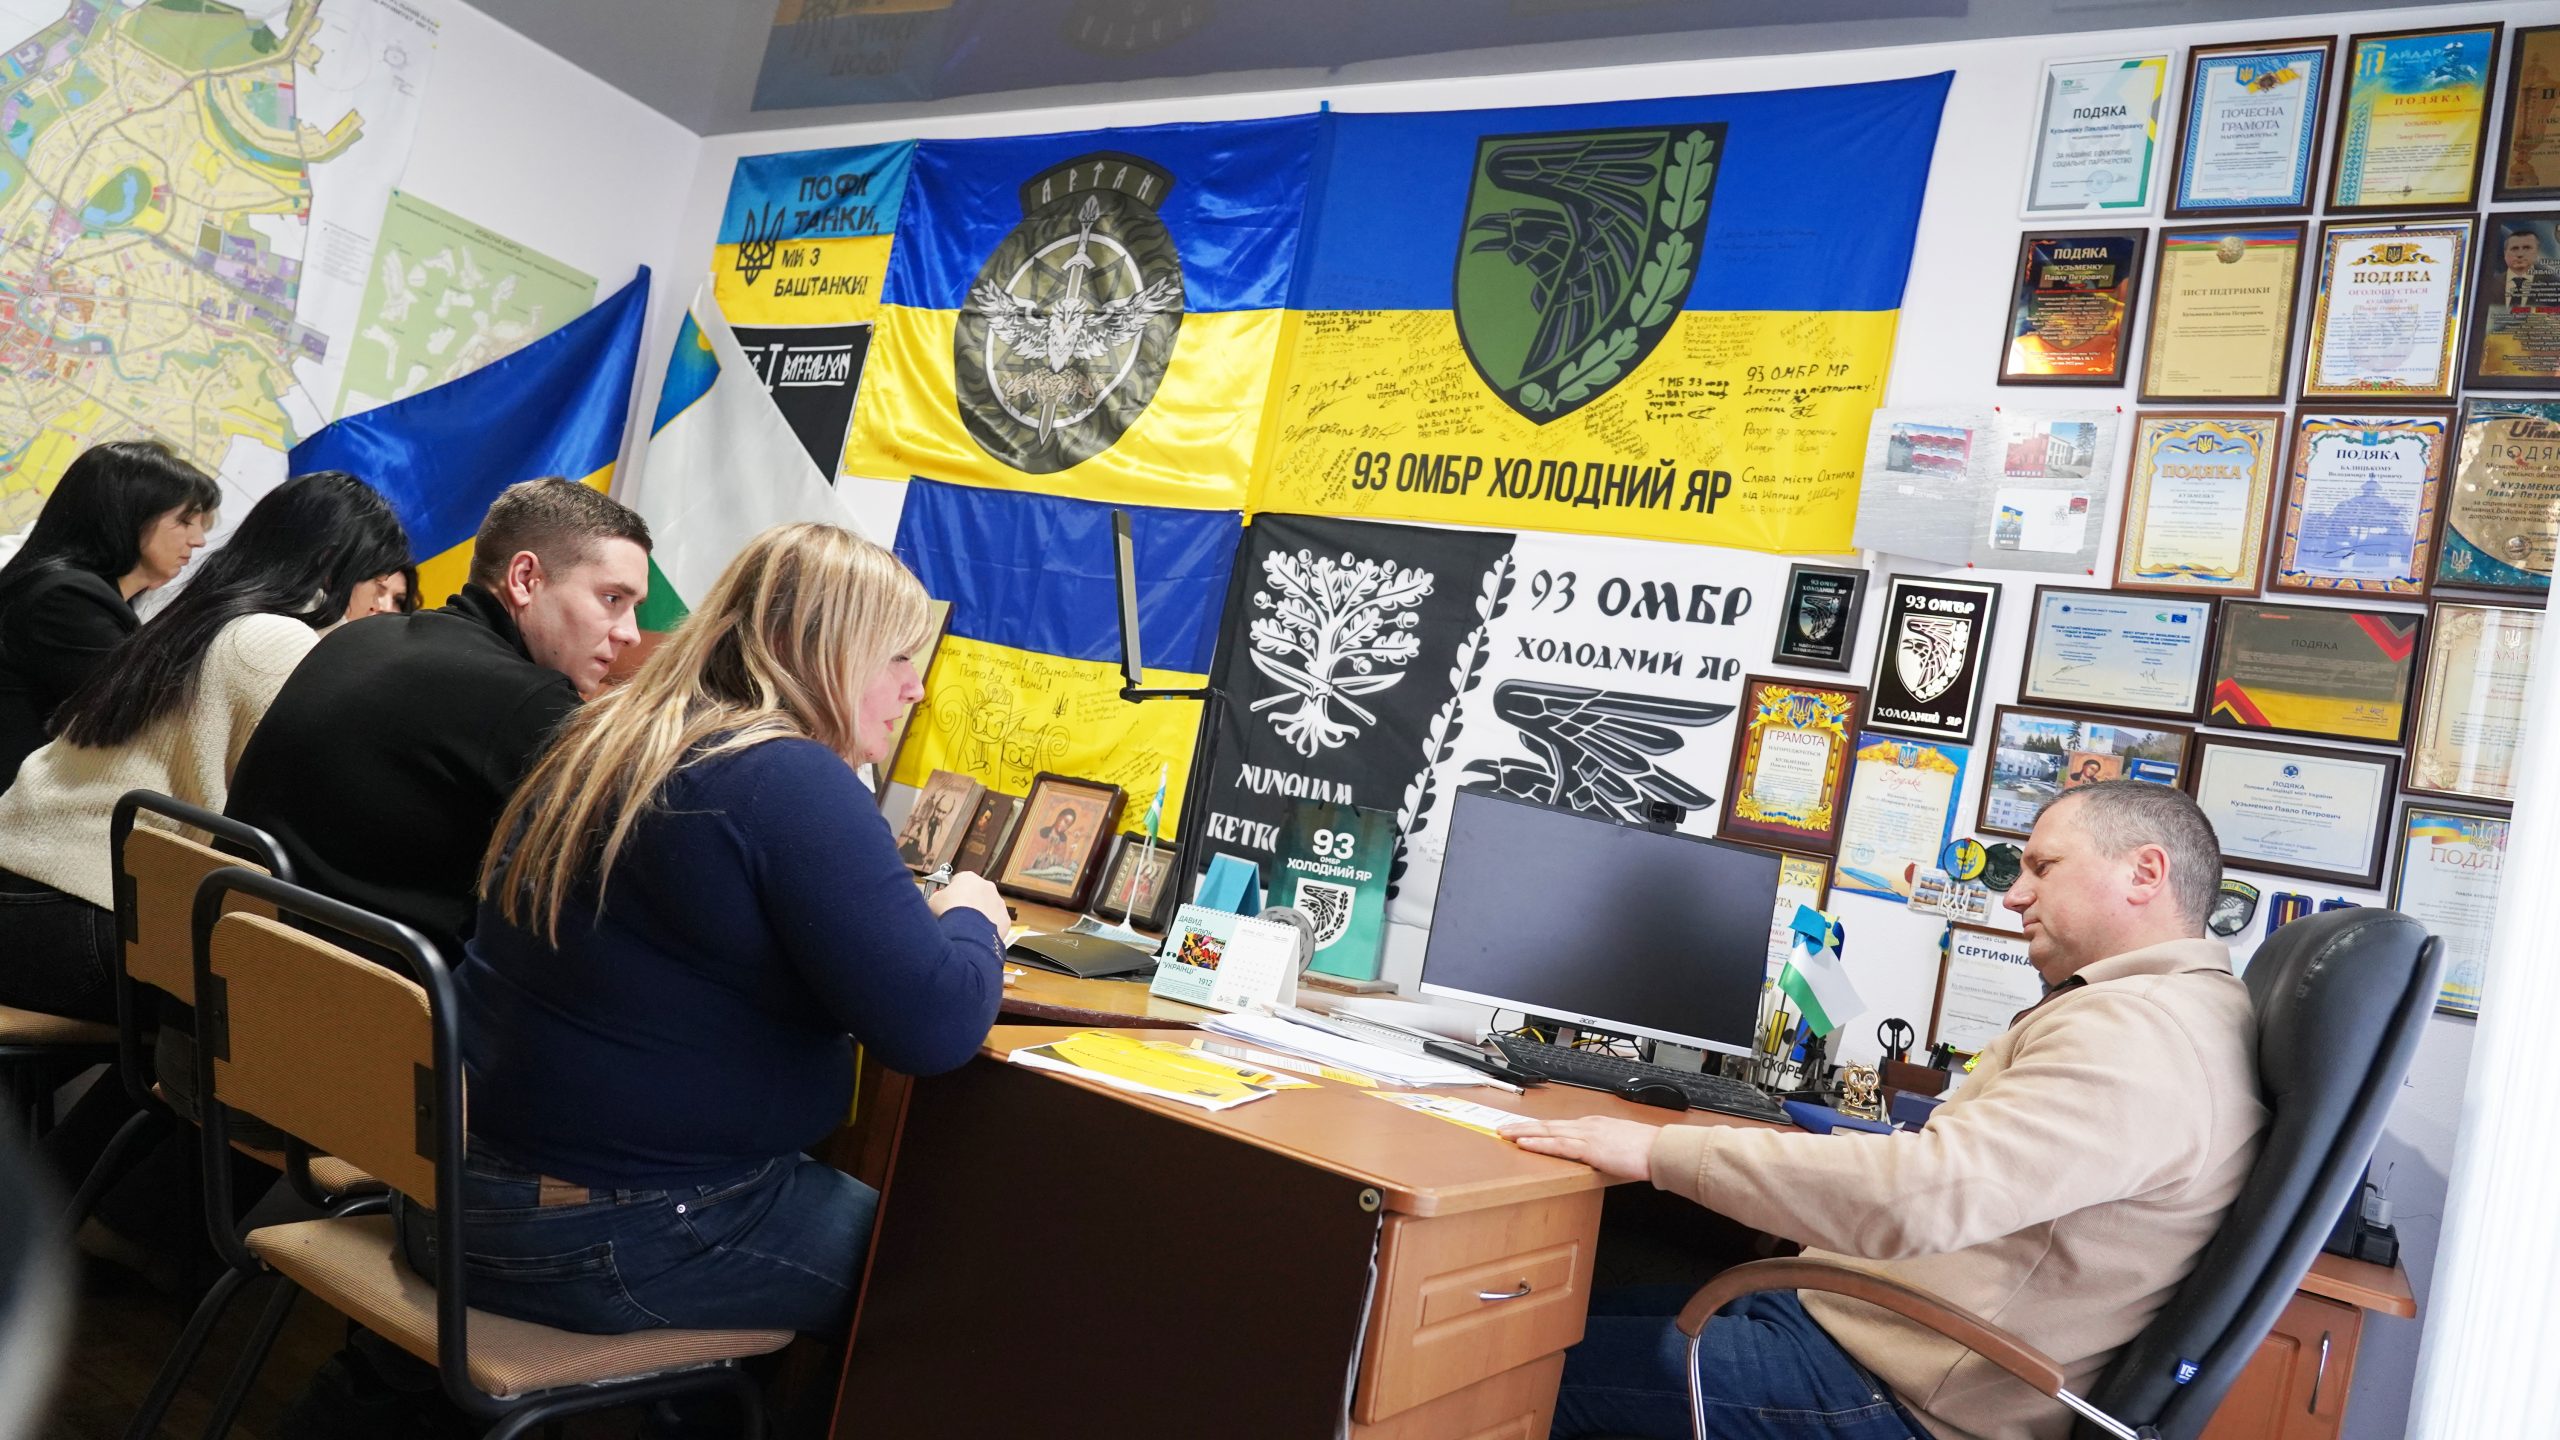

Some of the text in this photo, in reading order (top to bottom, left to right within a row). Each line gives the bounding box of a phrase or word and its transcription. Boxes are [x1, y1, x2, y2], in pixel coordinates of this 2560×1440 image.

[2394, 94, 2461, 106] ПОДЯКА
[2073, 105, 2127, 119] ПОДЯКА
[2221, 107, 2284, 118] ПОЧЕСНА
[2221, 120, 2280, 132] ГРАМОТА
[782, 249, 804, 267] МИ
[2054, 247, 2108, 260] ПОДЯКА
[2352, 270, 2431, 285] ПОДЯКА
[2181, 287, 2270, 297] ЛИСТ ПІДТРИМКИ
[1747, 366, 1764, 382] 93
[2336, 449, 2400, 461] ПОДЯКА
[2162, 463, 2242, 480] ПОДЯКА
[1352, 450, 1391, 490] 93
[1396, 453, 1483, 495] ОМБР
[1487, 457, 1677, 510] ХОЛОДНИЙ
[1680, 469, 1732, 514] ЯР
[1531, 569, 1752, 626] 93 ОМБР
[1905, 595, 1976, 614] 93 ОМБР
[2291, 639, 2338, 650] ПОДЯКА
[1514, 636, 1741, 681] ХОЛОДНИЙ ЯР
[1877, 707, 1963, 727] ХОЛОДНИЙ ЯР
[1768, 729, 1826, 748] ГРАМОТА
[2273, 780, 2305, 790] ПОДЯКА
[2231, 800, 2341, 819] Кузьменко Павло Петрович
[1312, 828, 1355, 860] 93
[1320, 856, 1341, 865] ОМБР
[1287, 857, 1372, 881] ХОЛОДНИЙ ЯР
[1178, 915, 1202, 927] ДАВИД
[1957, 945, 2032, 967] СЕРТИФІКА
[1198, 977, 1213, 986] 1912
